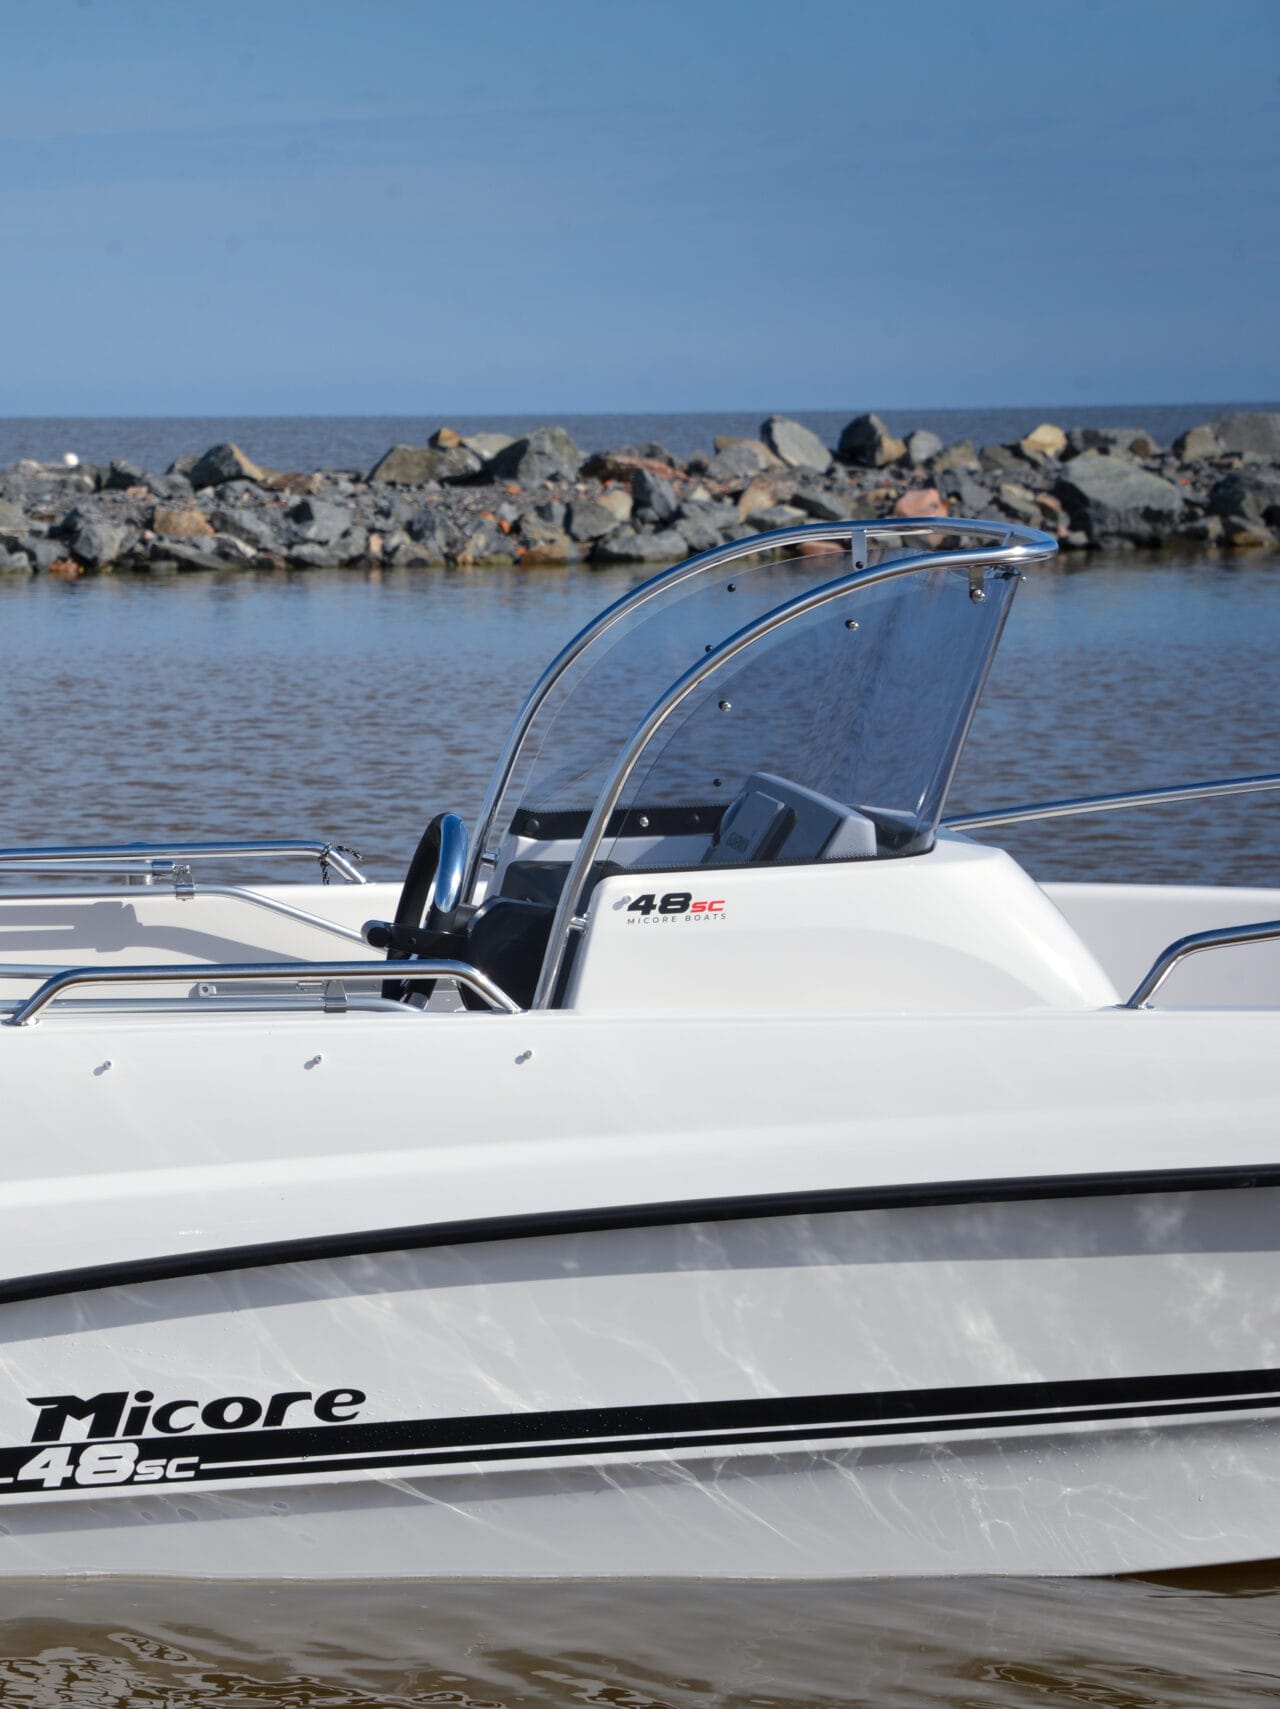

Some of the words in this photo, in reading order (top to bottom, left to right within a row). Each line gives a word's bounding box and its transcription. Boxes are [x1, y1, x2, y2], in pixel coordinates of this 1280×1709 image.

[627, 916, 677, 925] MICORE
[685, 913, 726, 922] BOATS
[26, 1388, 366, 1443] Micore
